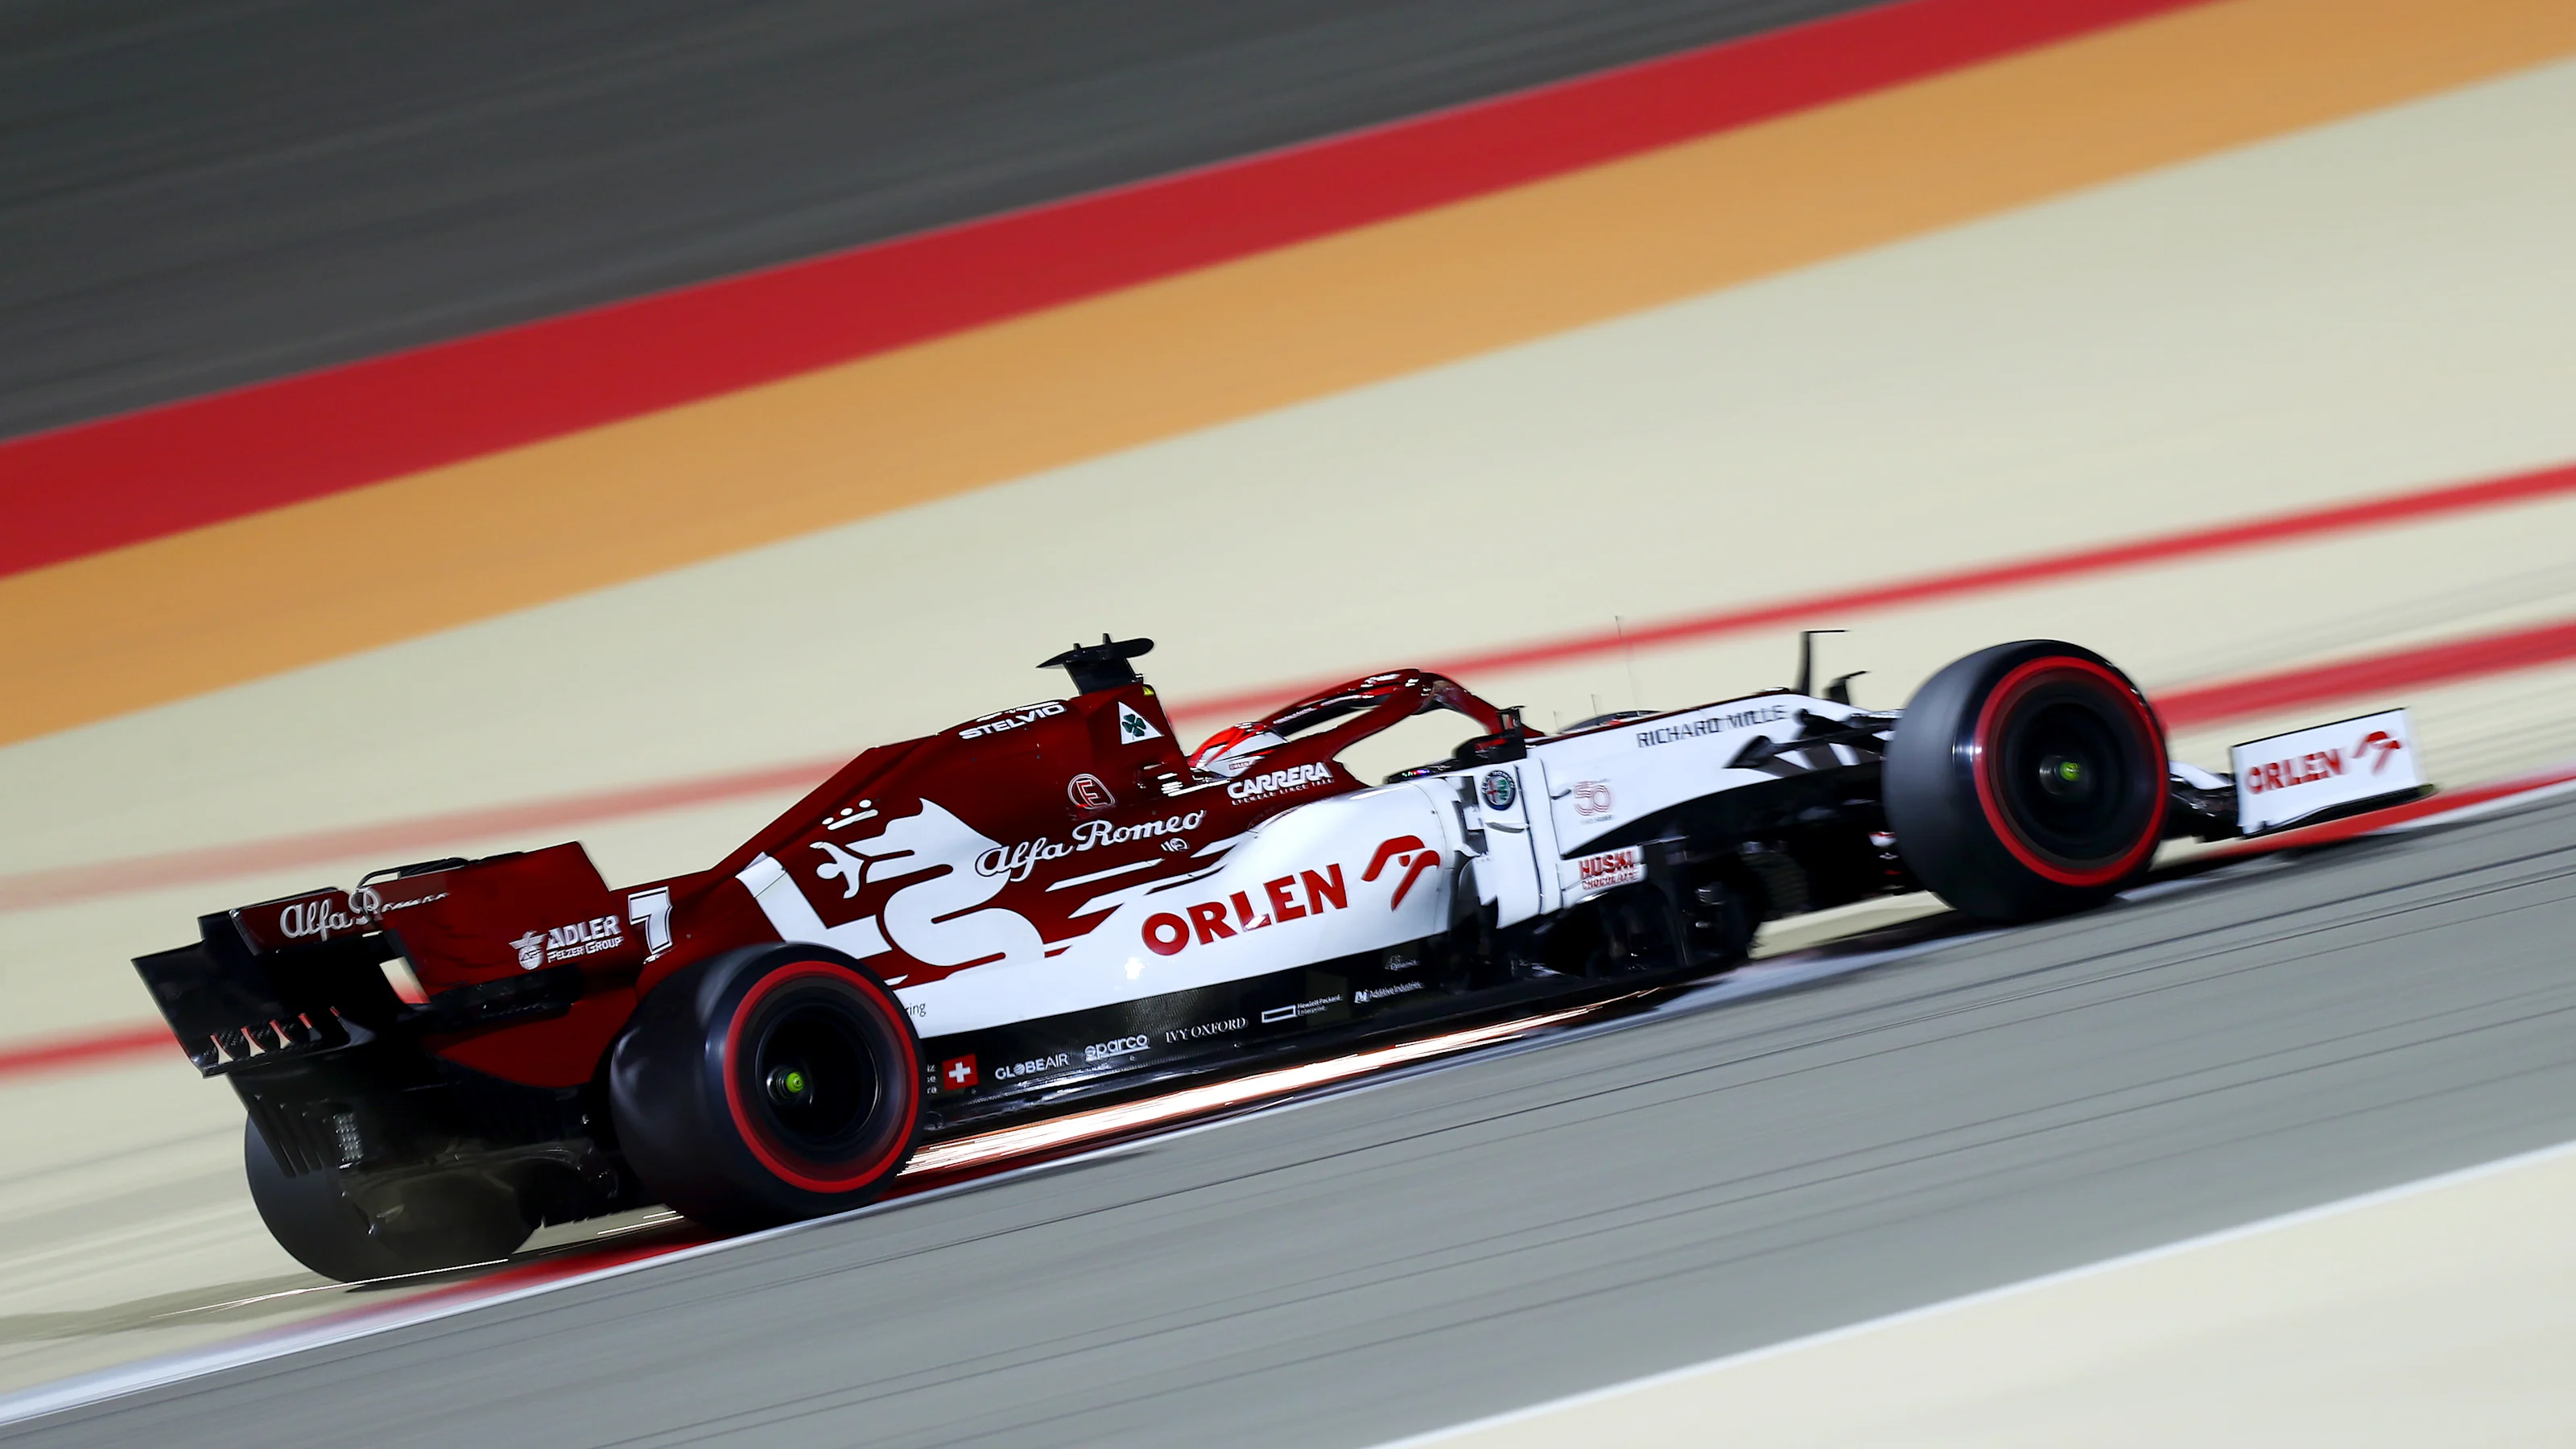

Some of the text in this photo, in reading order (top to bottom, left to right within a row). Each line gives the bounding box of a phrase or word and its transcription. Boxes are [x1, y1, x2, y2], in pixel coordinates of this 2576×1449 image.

[959, 704, 1067, 739] STELVIO
[1636, 704, 1789, 748] RICHARD MILLE
[1227, 762, 1333, 799] CARRERA
[2246, 747, 2351, 795] ORLEN
[975, 809, 1207, 882] Alfa Romeo
[1579, 851, 1634, 880] HUSKI
[279, 898, 353, 942] Alfa
[628, 886, 673, 955] 7
[1141, 863, 1348, 956] ORLEN
[547, 915, 622, 950] ADLER
[547, 936, 625, 964] PELZER GROUP
[1084, 1034, 1149, 1062] sparco
[1166, 1017, 1248, 1044] IVY OXFORD
[995, 1053, 1070, 1080] GLOBEAIR
